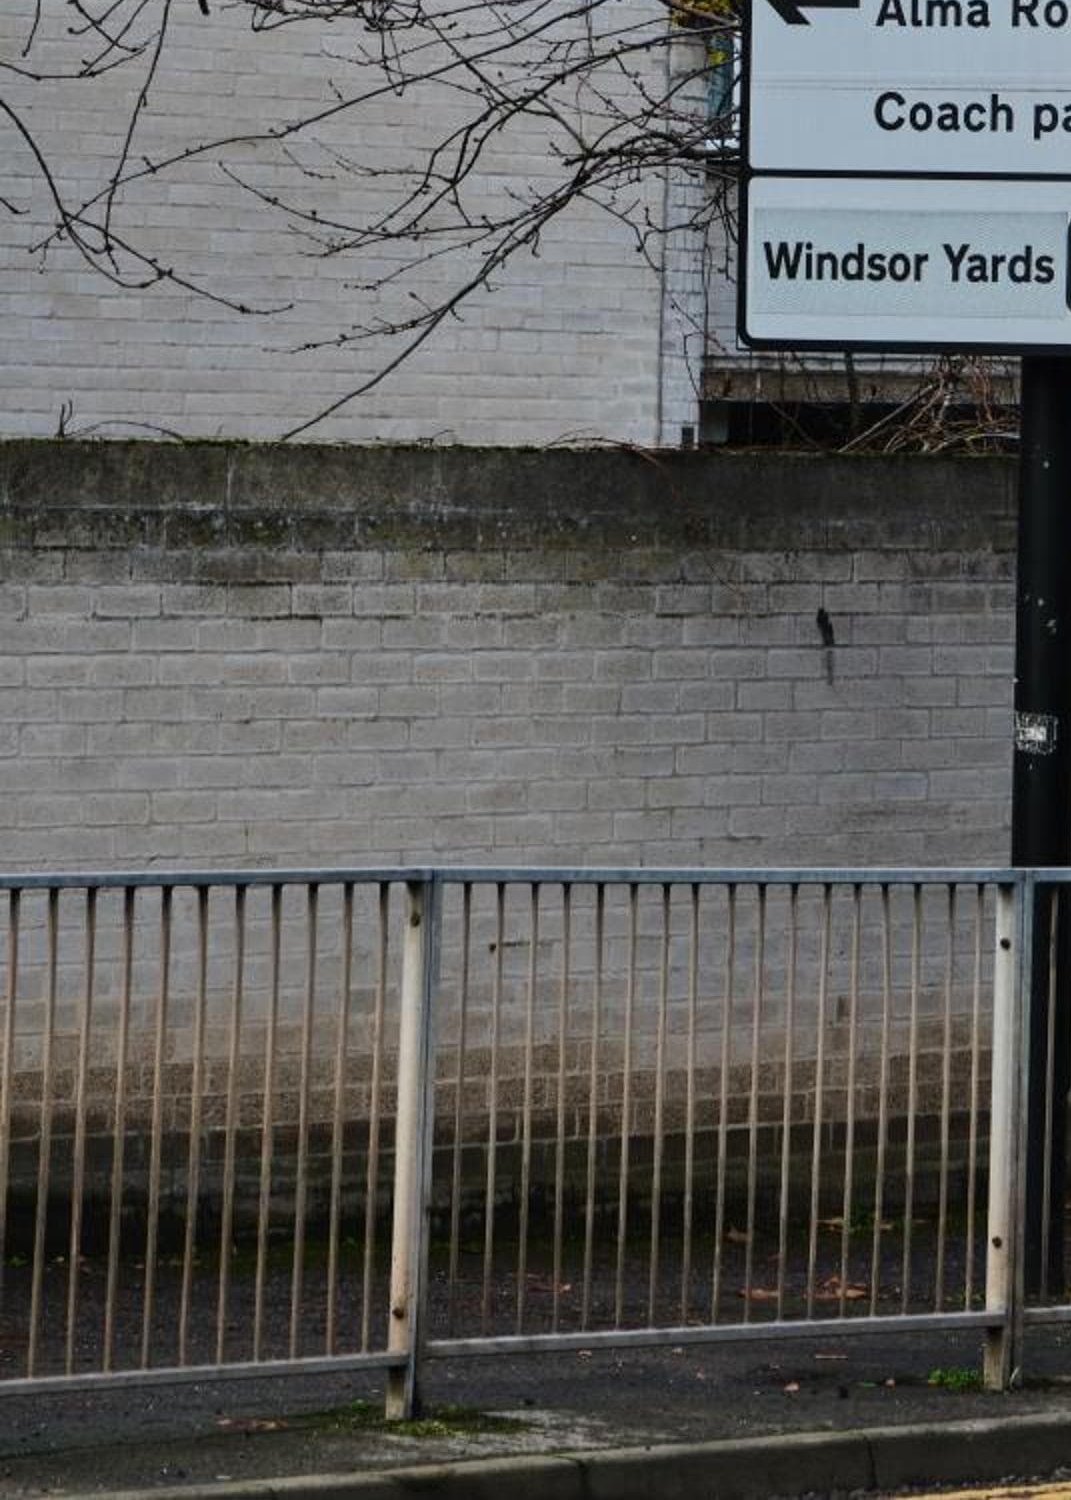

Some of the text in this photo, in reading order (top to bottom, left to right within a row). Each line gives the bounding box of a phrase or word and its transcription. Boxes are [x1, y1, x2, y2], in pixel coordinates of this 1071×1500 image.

[873, 91, 1014, 133] Coach
[763, 241, 1055, 285] Windsor Yards
